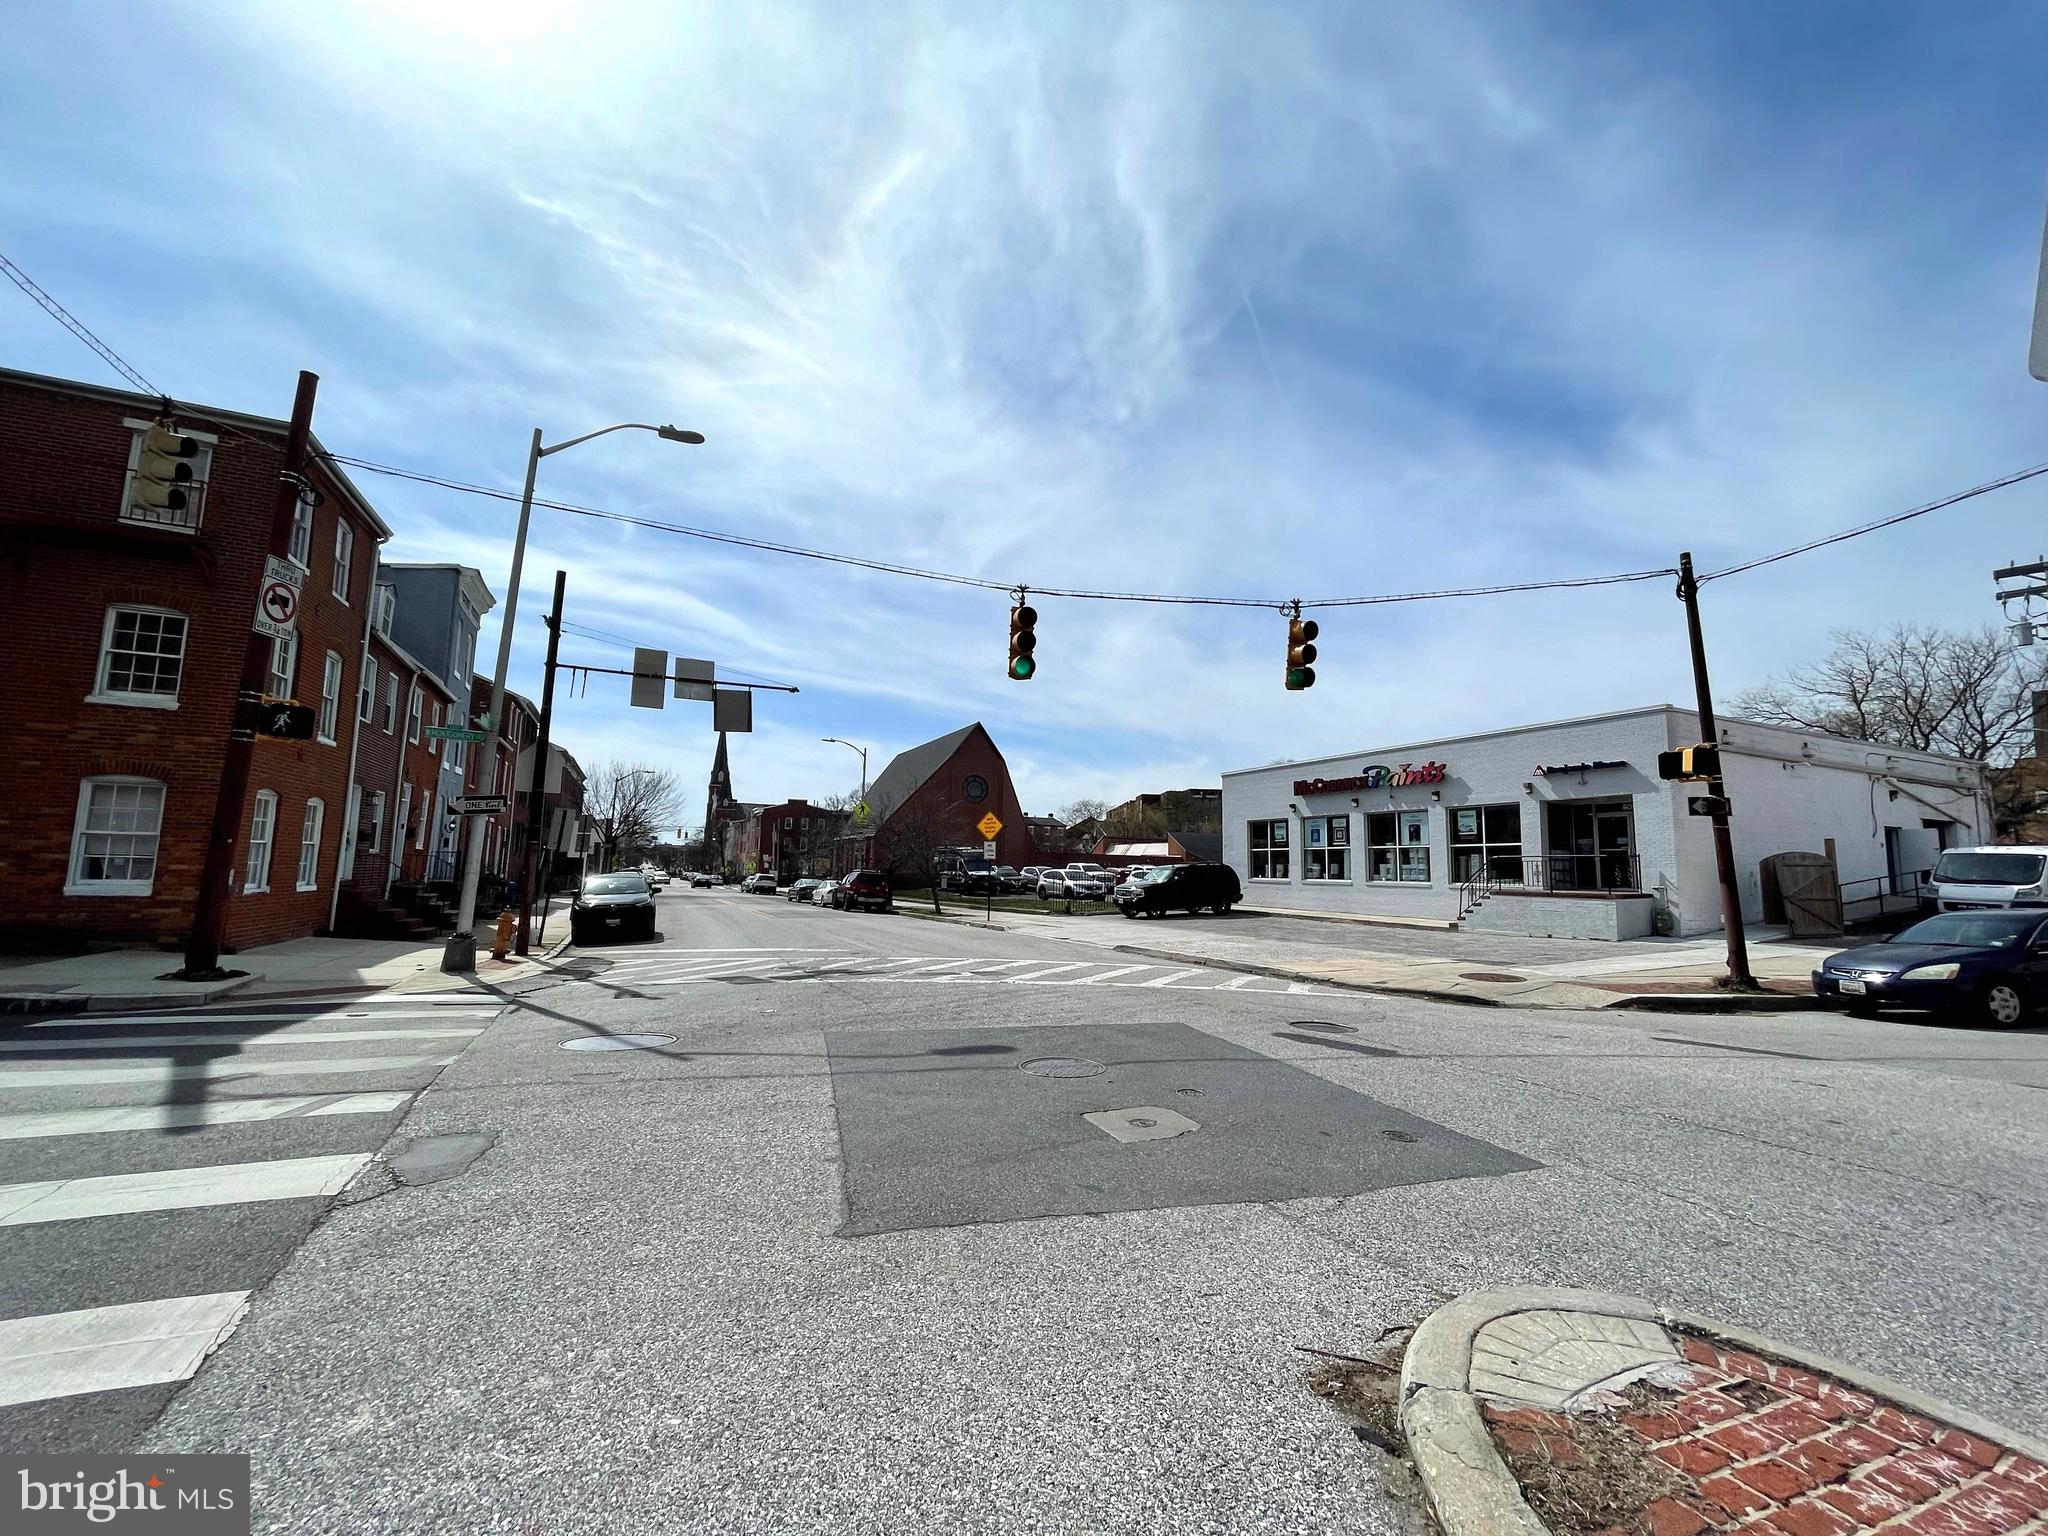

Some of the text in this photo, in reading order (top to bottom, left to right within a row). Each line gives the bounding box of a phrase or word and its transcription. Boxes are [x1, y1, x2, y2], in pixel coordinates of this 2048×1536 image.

[271, 568, 299, 585] TRUCKS
[277, 561, 296, 575] THRU
[257, 620, 273, 632] OVER
[281, 627, 292, 638] TON
[1362, 761, 1447, 789] Paints
[465, 800, 502, 809] ONE WAY
